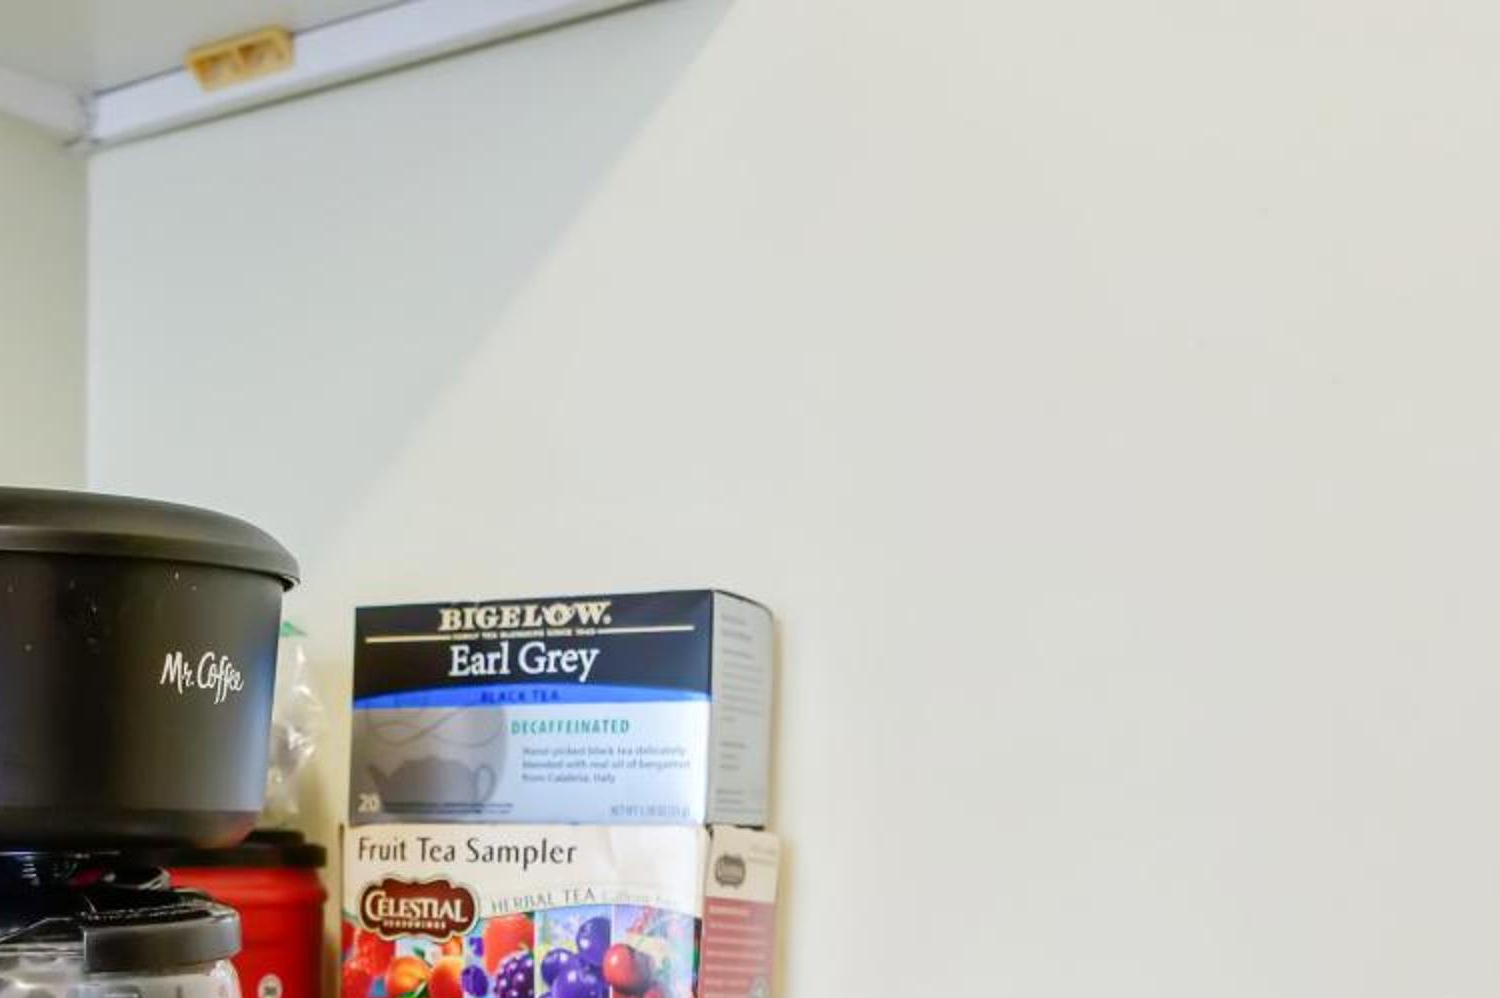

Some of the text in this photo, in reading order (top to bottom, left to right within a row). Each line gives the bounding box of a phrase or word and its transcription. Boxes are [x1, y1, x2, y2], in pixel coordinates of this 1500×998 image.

[448, 641, 600, 683] Earl Grey
[159, 651, 245, 705] Mr. Coffee
[480, 689, 560, 703] BLACK TEA
[510, 719, 630, 735] DECAFFEINATED
[358, 793, 382, 813] 20
[358, 837, 577, 870] Fruit Tea Sampler
[365, 890, 469, 923] CELESTIAL
[491, 893, 553, 913] HERBAL
[563, 888, 596, 901] TEA
